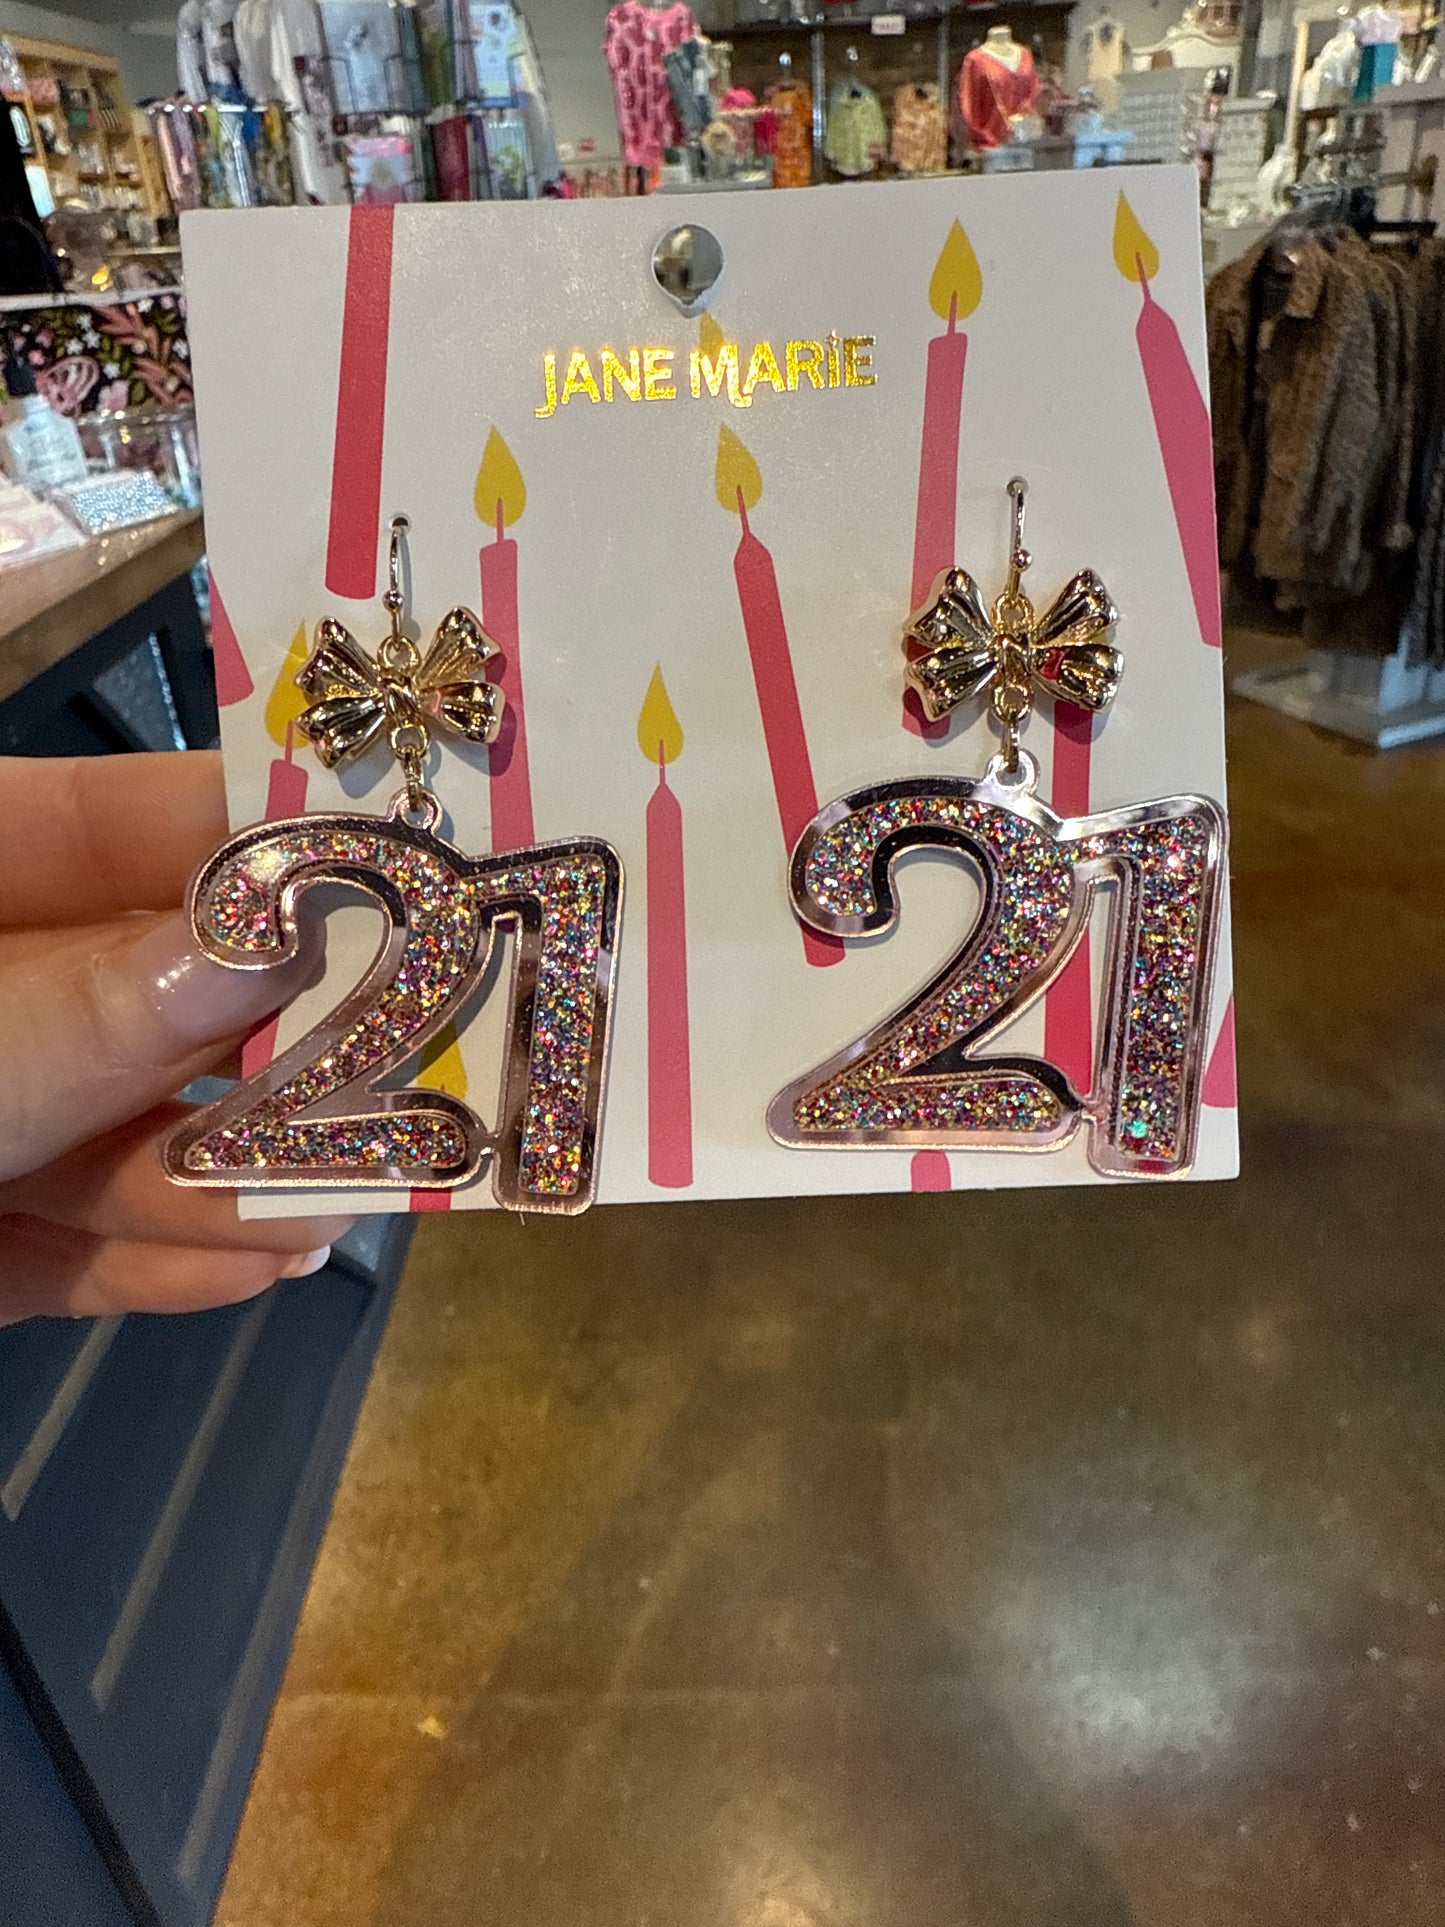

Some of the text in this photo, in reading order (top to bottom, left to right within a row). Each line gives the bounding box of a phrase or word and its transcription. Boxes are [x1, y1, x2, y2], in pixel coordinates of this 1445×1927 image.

[534, 347, 678, 419] JANE
[164, 811, 626, 1217] 21
[765, 775, 1228, 1181] 21
